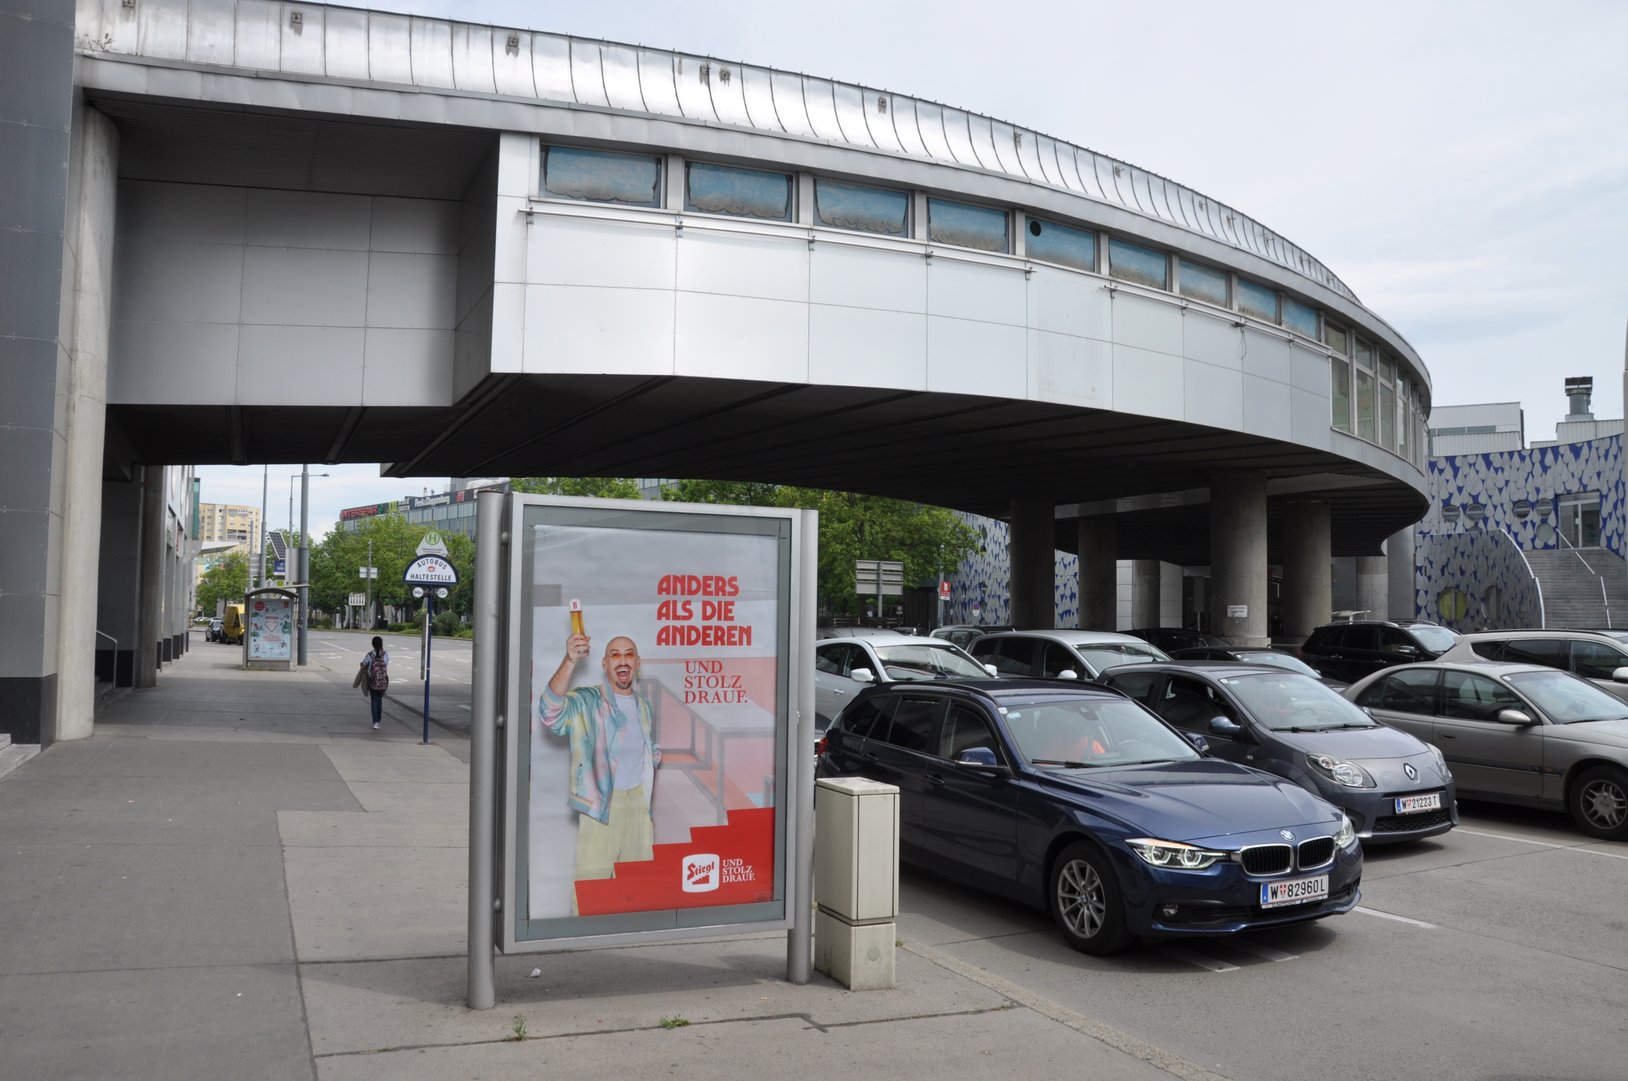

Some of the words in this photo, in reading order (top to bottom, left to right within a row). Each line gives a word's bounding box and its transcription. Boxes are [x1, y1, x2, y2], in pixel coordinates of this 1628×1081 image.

[417, 558, 448, 570] AUTOBUS
[410, 573, 452, 581] HALTESTELLE
[657, 574, 740, 597] ANDERS
[656, 599, 694, 621] ALS
[701, 600, 735, 621] DIE
[656, 625, 752, 646] ANDEREN
[685, 660, 723, 674] UND
[684, 675, 742, 689] STOLZ
[683, 690, 748, 705] DRAUF.
[722, 858, 744, 868] UND
[722, 865, 753, 875] STOLZ
[687, 861, 715, 881] Stiegl
[722, 873, 756, 883] DRAUF.
[1270, 885, 1279, 900] W
